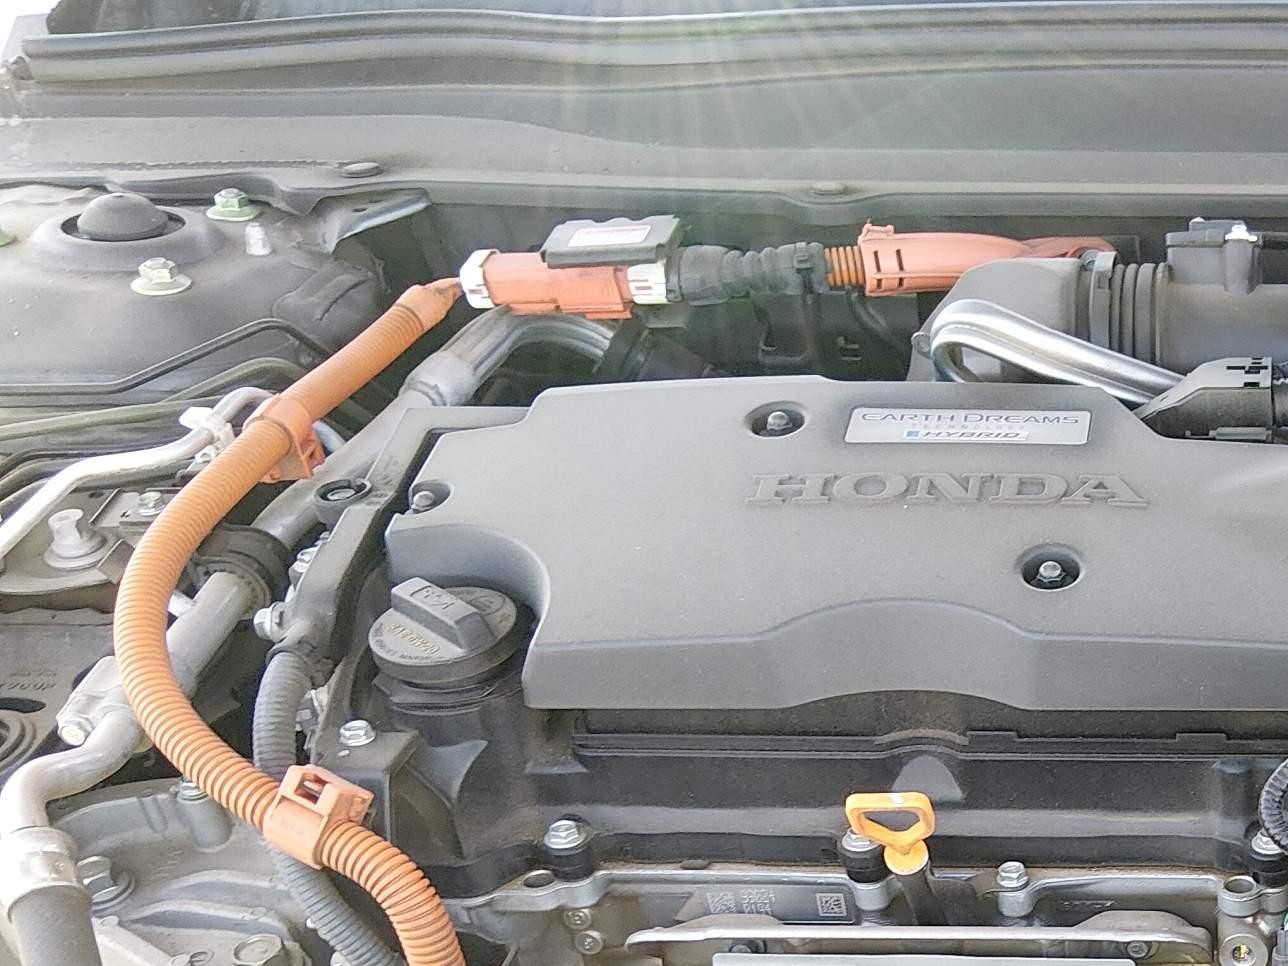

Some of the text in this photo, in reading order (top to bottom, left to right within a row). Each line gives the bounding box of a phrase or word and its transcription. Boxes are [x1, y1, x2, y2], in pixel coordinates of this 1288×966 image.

[861, 412, 1080, 424] EARTH DREAMS
[923, 431, 1020, 439] HYBRID
[745, 472, 1149, 508] HONDA
